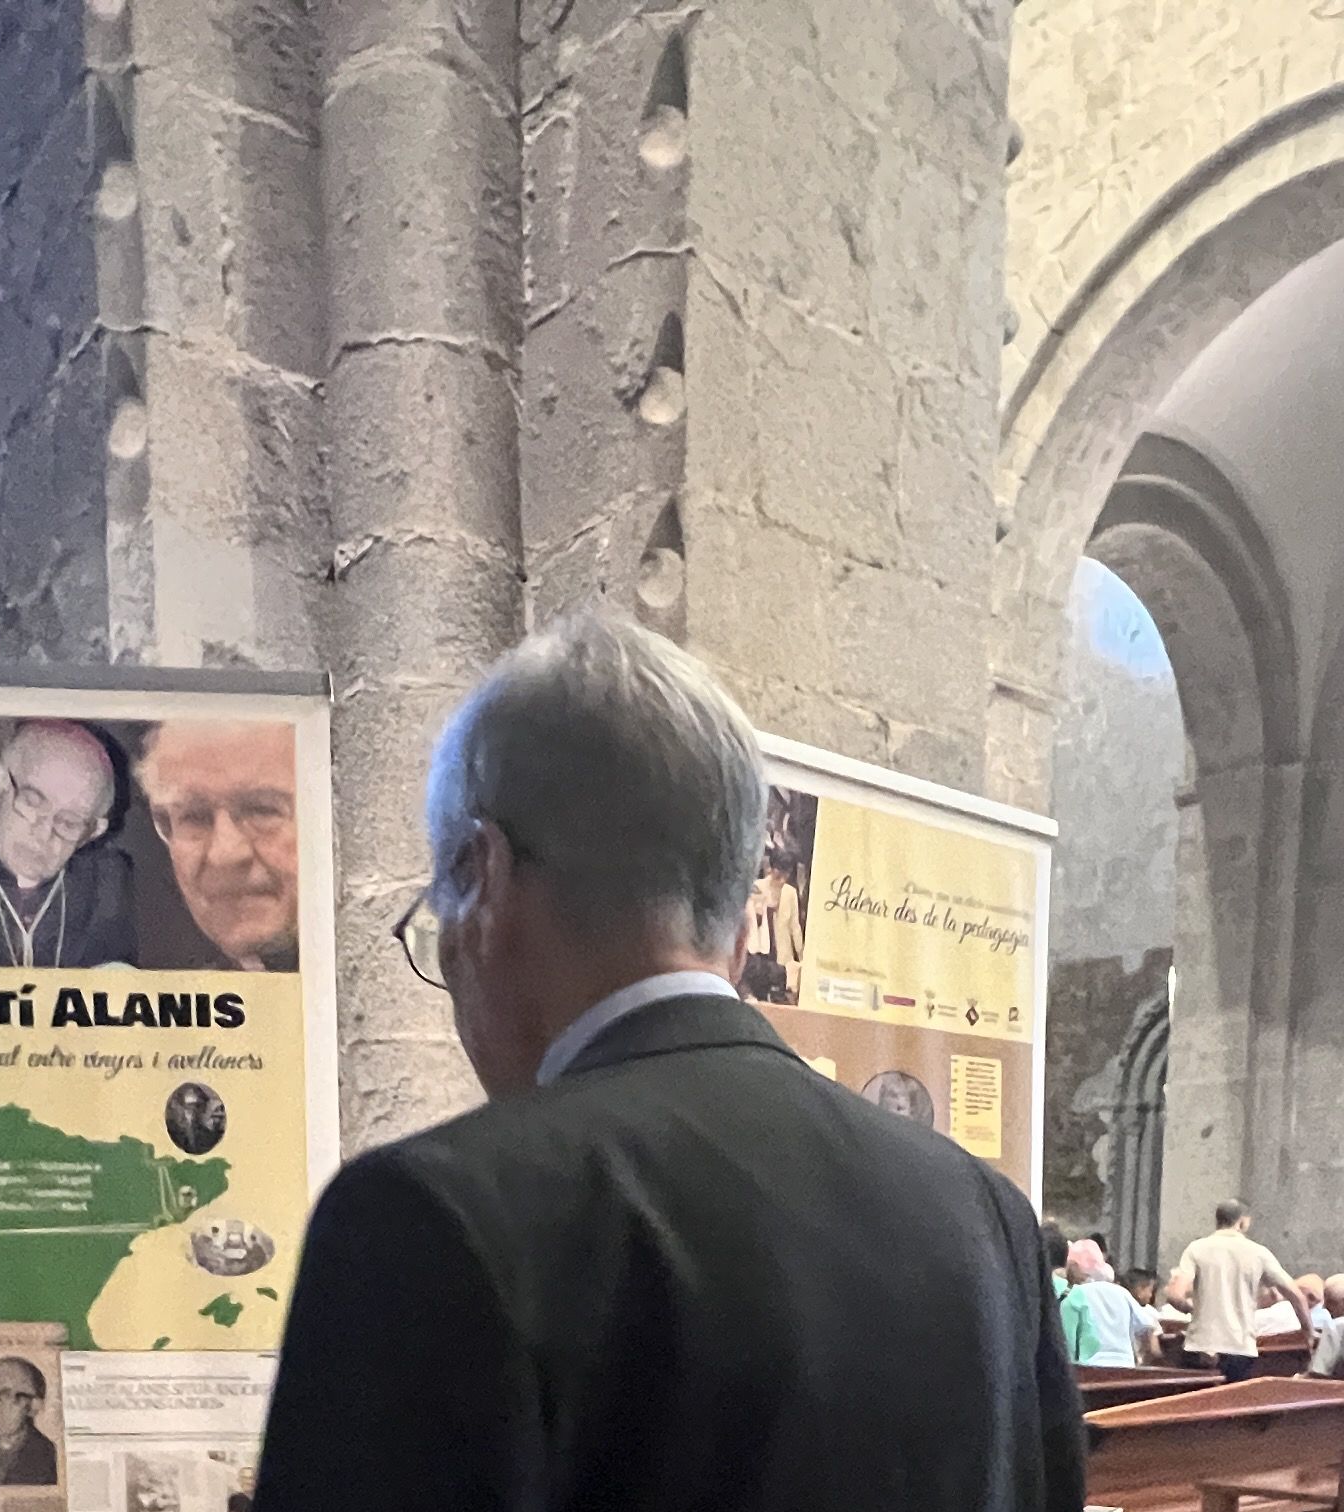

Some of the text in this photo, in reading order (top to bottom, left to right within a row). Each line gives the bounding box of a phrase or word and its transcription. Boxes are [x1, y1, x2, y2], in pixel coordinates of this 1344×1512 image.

[824, 875, 889, 922] Liderar
[894, 898, 917, 924] des
[923, 903, 938, 927] de
[943, 907, 957, 932] la
[51, 987, 246, 1028] ALANIS
